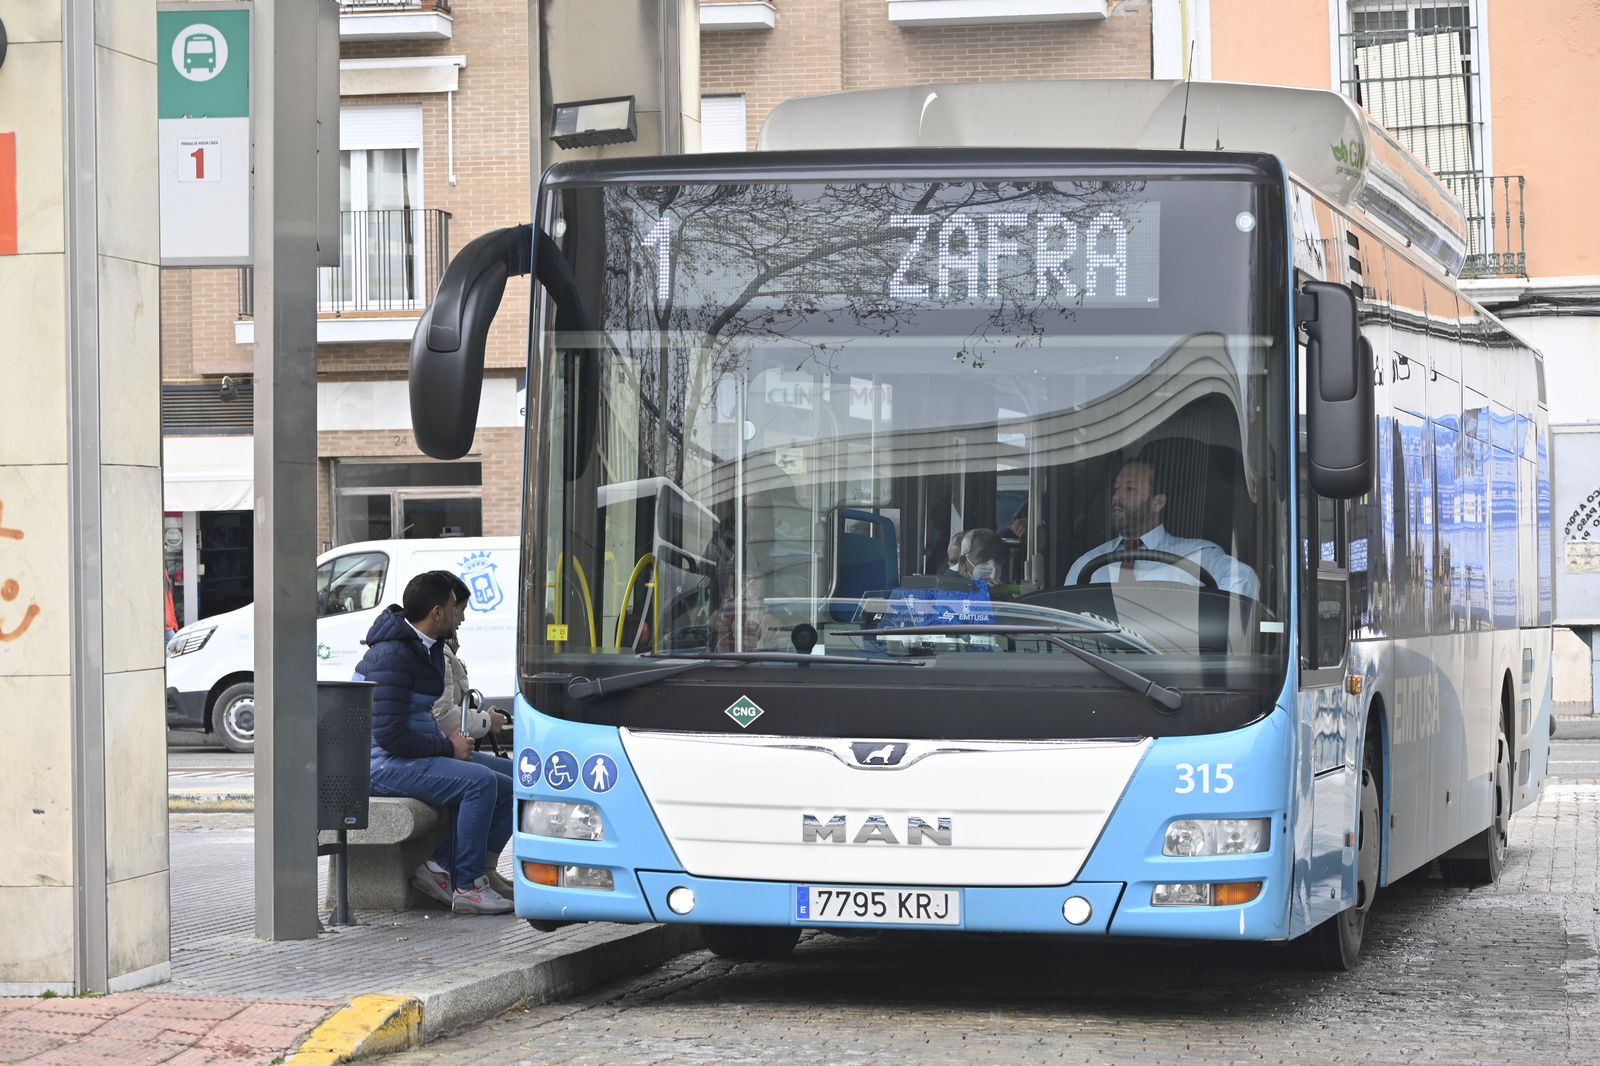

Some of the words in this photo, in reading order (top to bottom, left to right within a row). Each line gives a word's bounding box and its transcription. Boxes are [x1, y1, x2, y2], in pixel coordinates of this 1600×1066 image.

[191, 148, 204, 179] 1
[640, 216, 670, 299] 1
[888, 212, 1128, 298] ZAFRA
[393, 435, 407, 447] 24
[958, 612, 989, 622] EMTUSA
[732, 706, 756, 717] CNG
[1174, 763, 1235, 794] 315
[802, 814, 953, 846] MAN
[800, 905, 807, 914] E
[817, 890, 888, 918] 7795
[898, 892, 949, 919] KRJ
